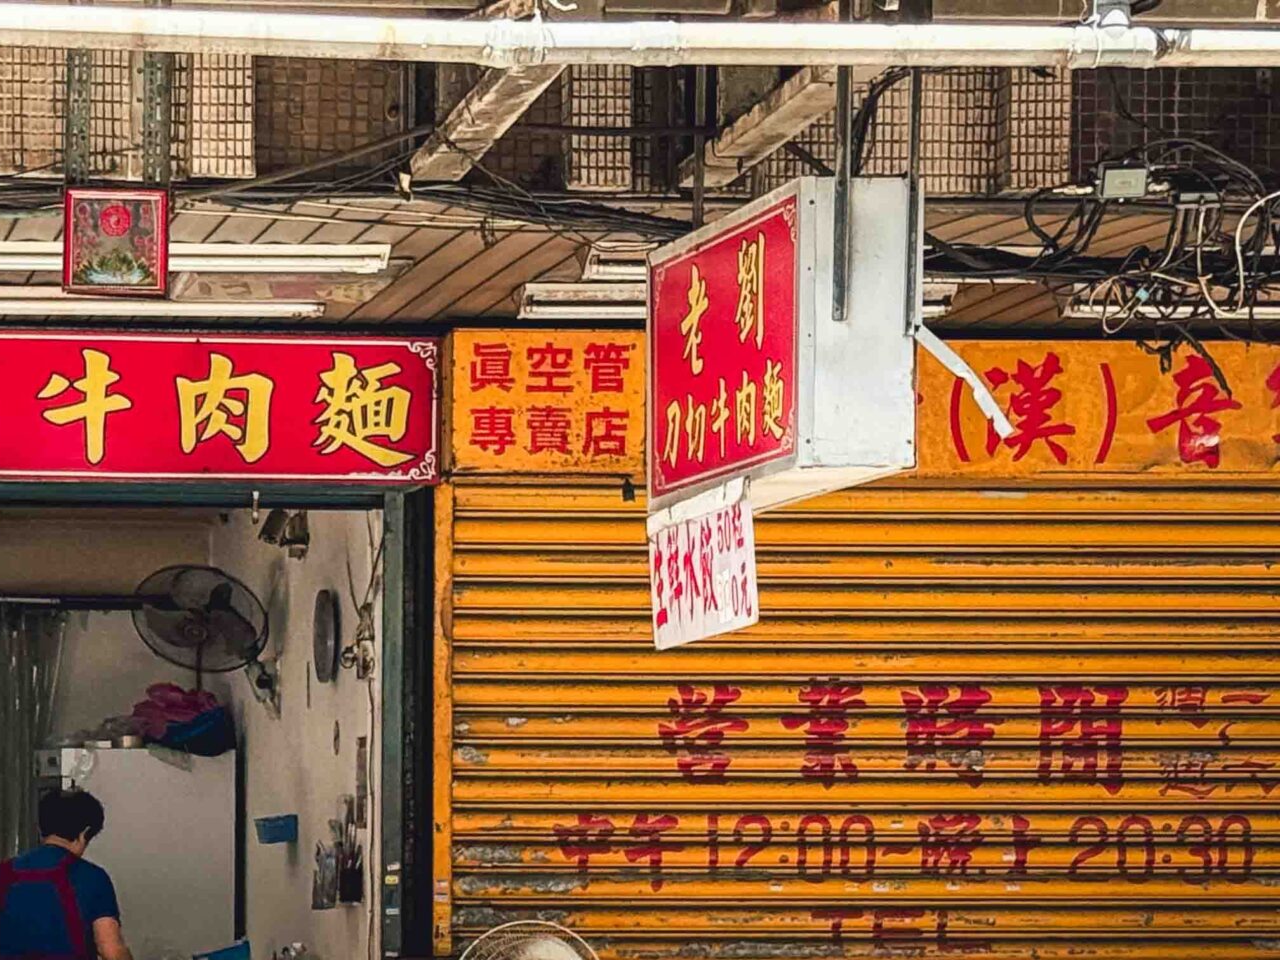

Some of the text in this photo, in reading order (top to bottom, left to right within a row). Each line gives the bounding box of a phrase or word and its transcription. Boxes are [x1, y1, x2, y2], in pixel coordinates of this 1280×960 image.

[680, 231, 766, 376] 老劉
[469, 405, 630, 457] 專賣店
[663, 358, 786, 470] 刀切牛肉麵
[658, 685, 1129, 796] 營業時間
[810, 909, 992, 952] TEL
